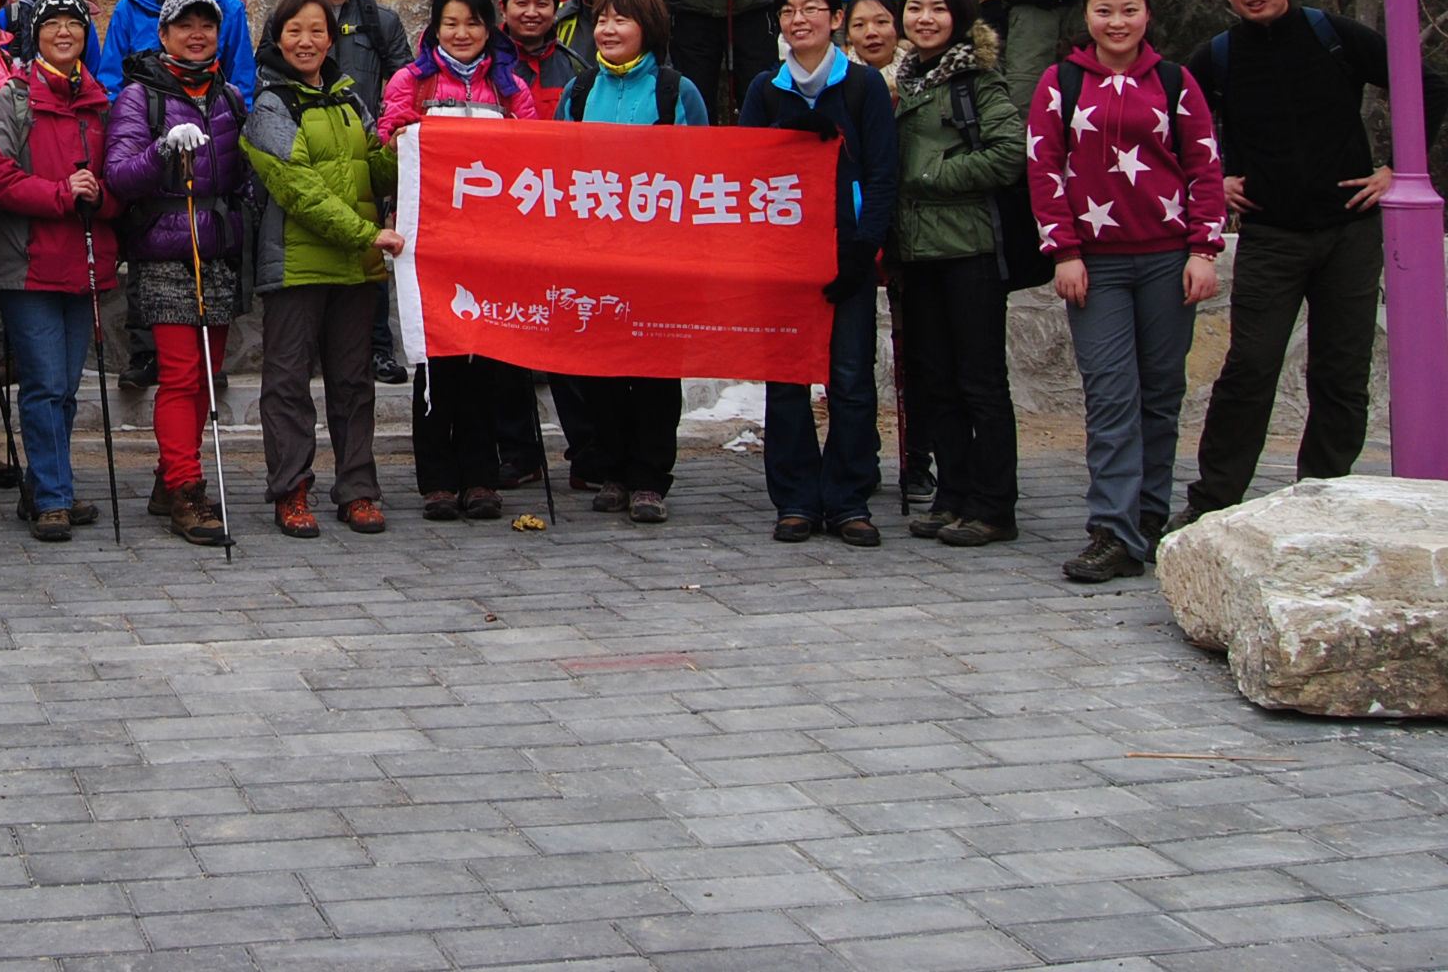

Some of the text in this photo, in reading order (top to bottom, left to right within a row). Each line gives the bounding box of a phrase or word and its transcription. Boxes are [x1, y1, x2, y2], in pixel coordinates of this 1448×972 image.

[451, 160, 803, 225] 户外我的生活
[481, 284, 631, 333] 红火柴 畅享户外
